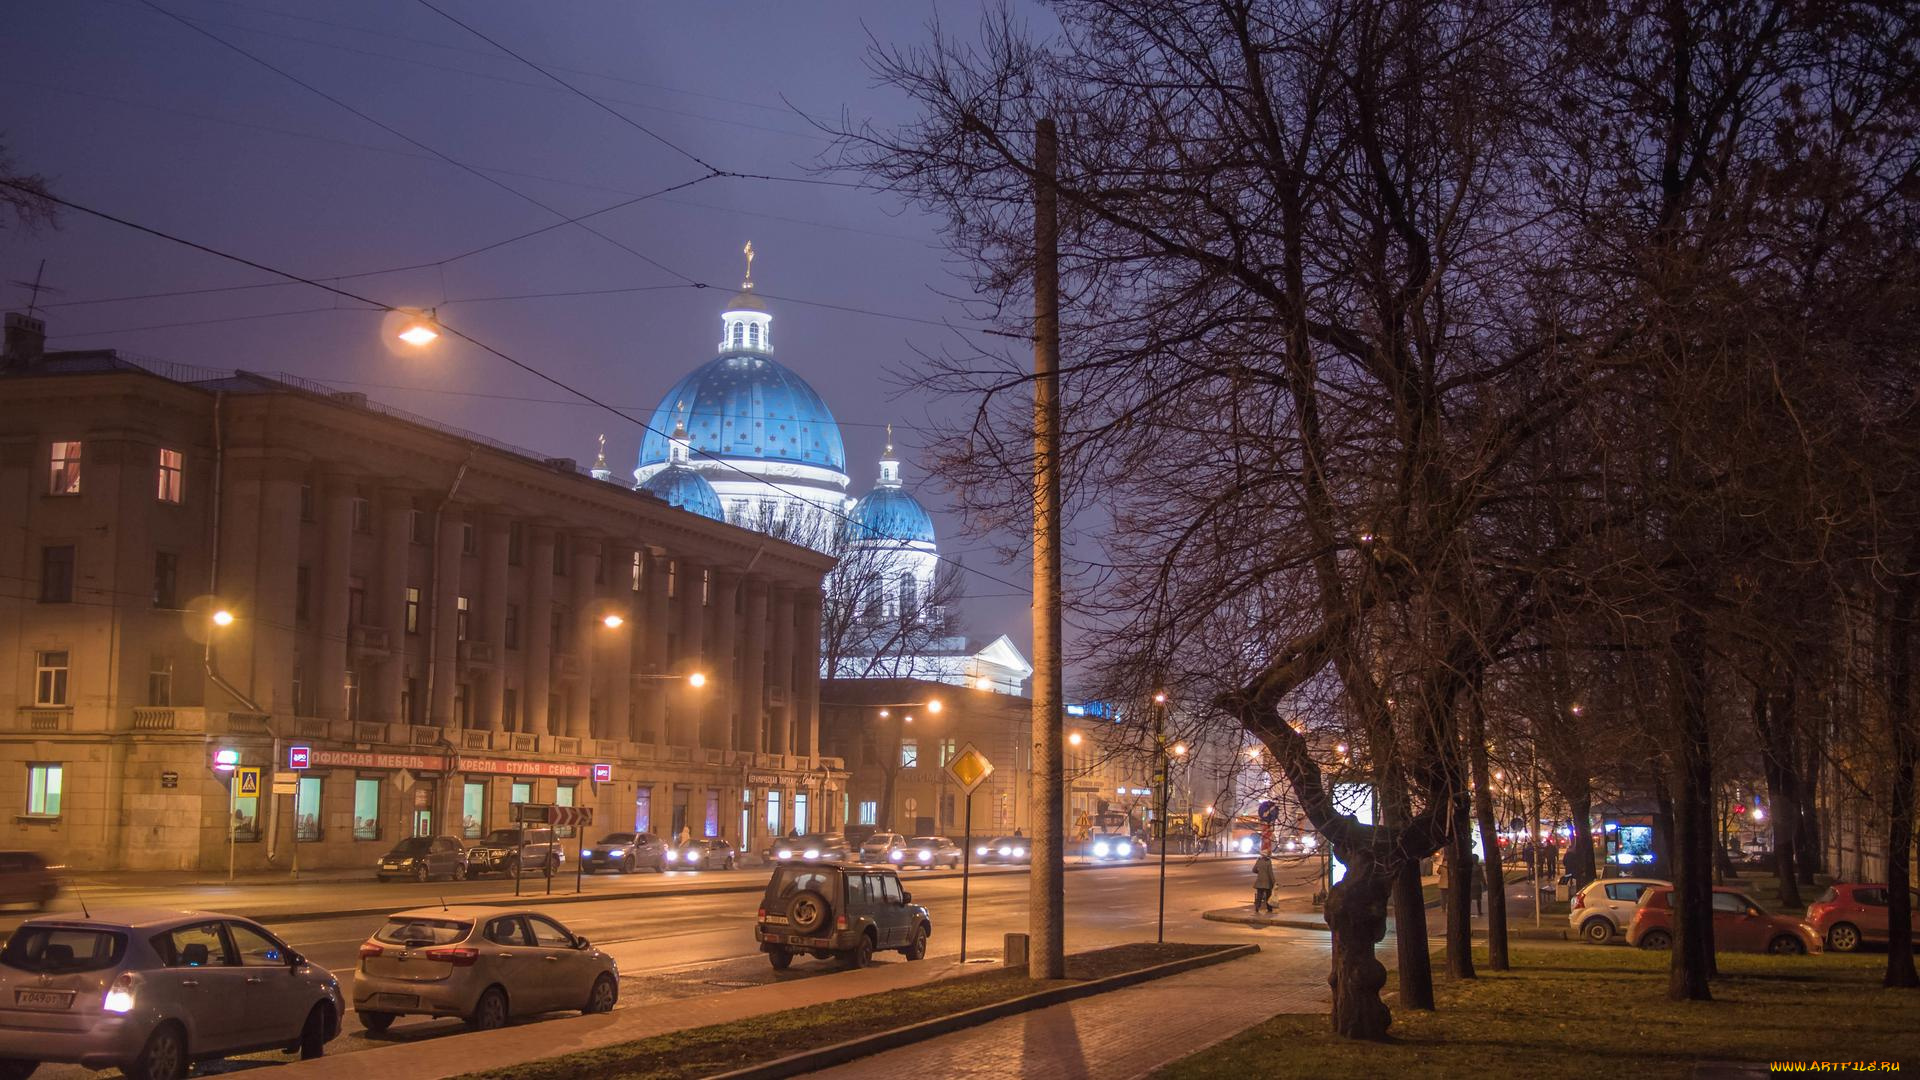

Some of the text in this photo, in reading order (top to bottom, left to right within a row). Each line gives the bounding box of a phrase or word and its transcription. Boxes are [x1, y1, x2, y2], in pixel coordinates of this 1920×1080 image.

[311, 751, 373, 765] ОФИСНАЯ
[377, 756, 424, 768] МЕБЕЛЬ
[459, 759, 580, 776] КРЕСЛА СТУЛЬЯ СЕЙФЫ
